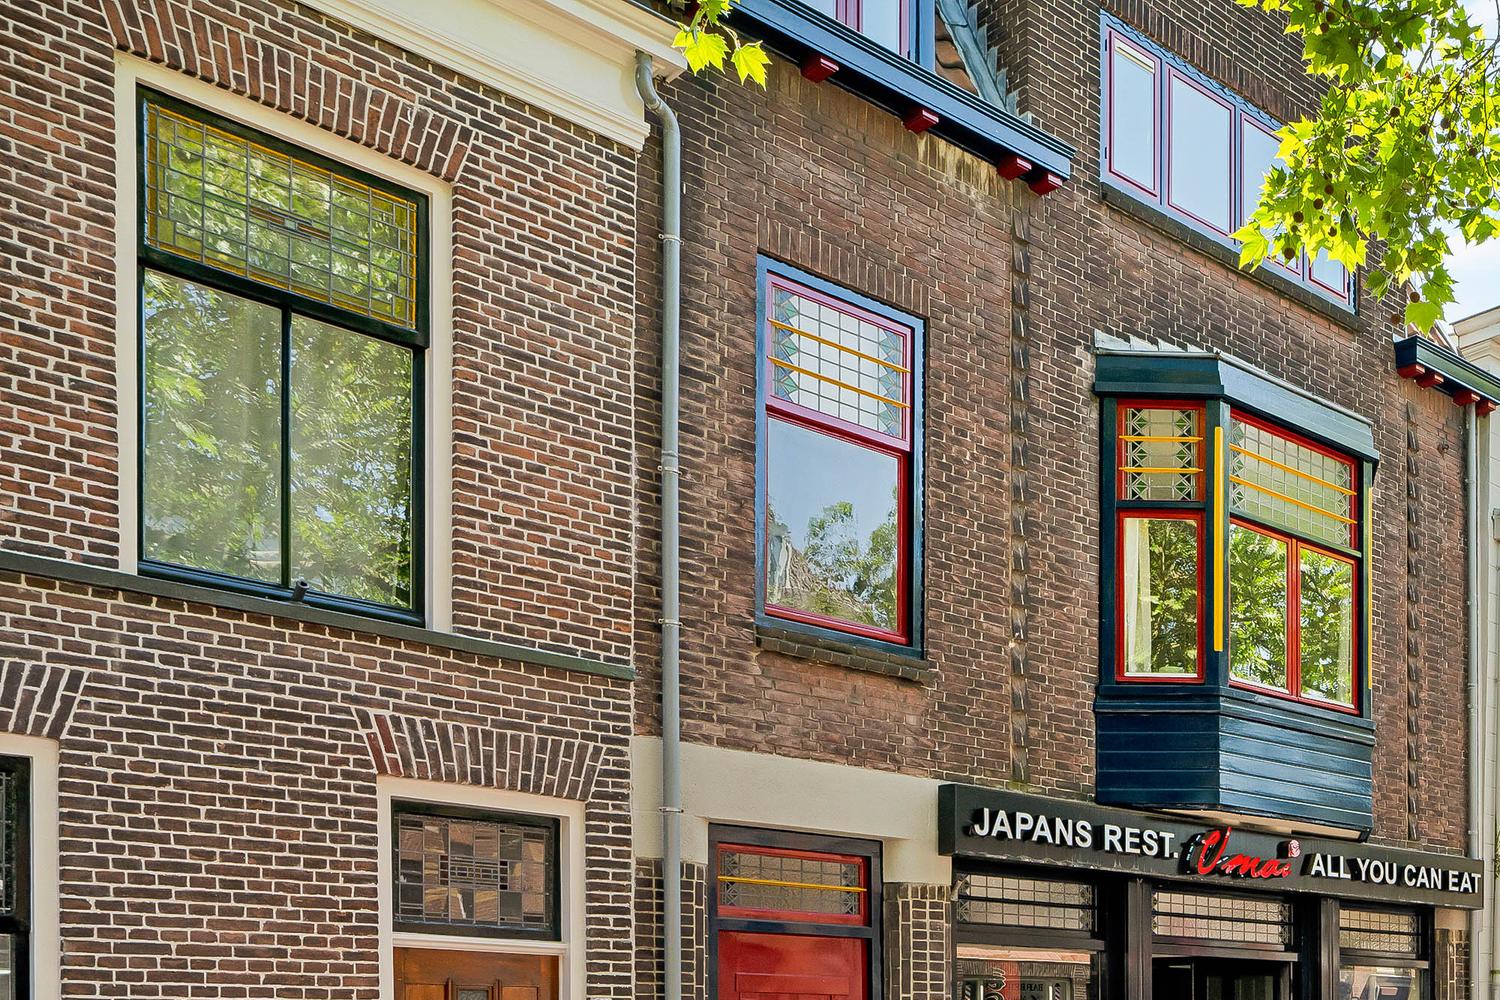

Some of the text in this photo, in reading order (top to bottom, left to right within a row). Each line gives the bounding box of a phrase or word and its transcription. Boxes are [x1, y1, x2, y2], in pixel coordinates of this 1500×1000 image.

[974, 807, 1179, 859] JAPANS REST.
[1310, 853, 1482, 894] ALL YOU CAN EAT
